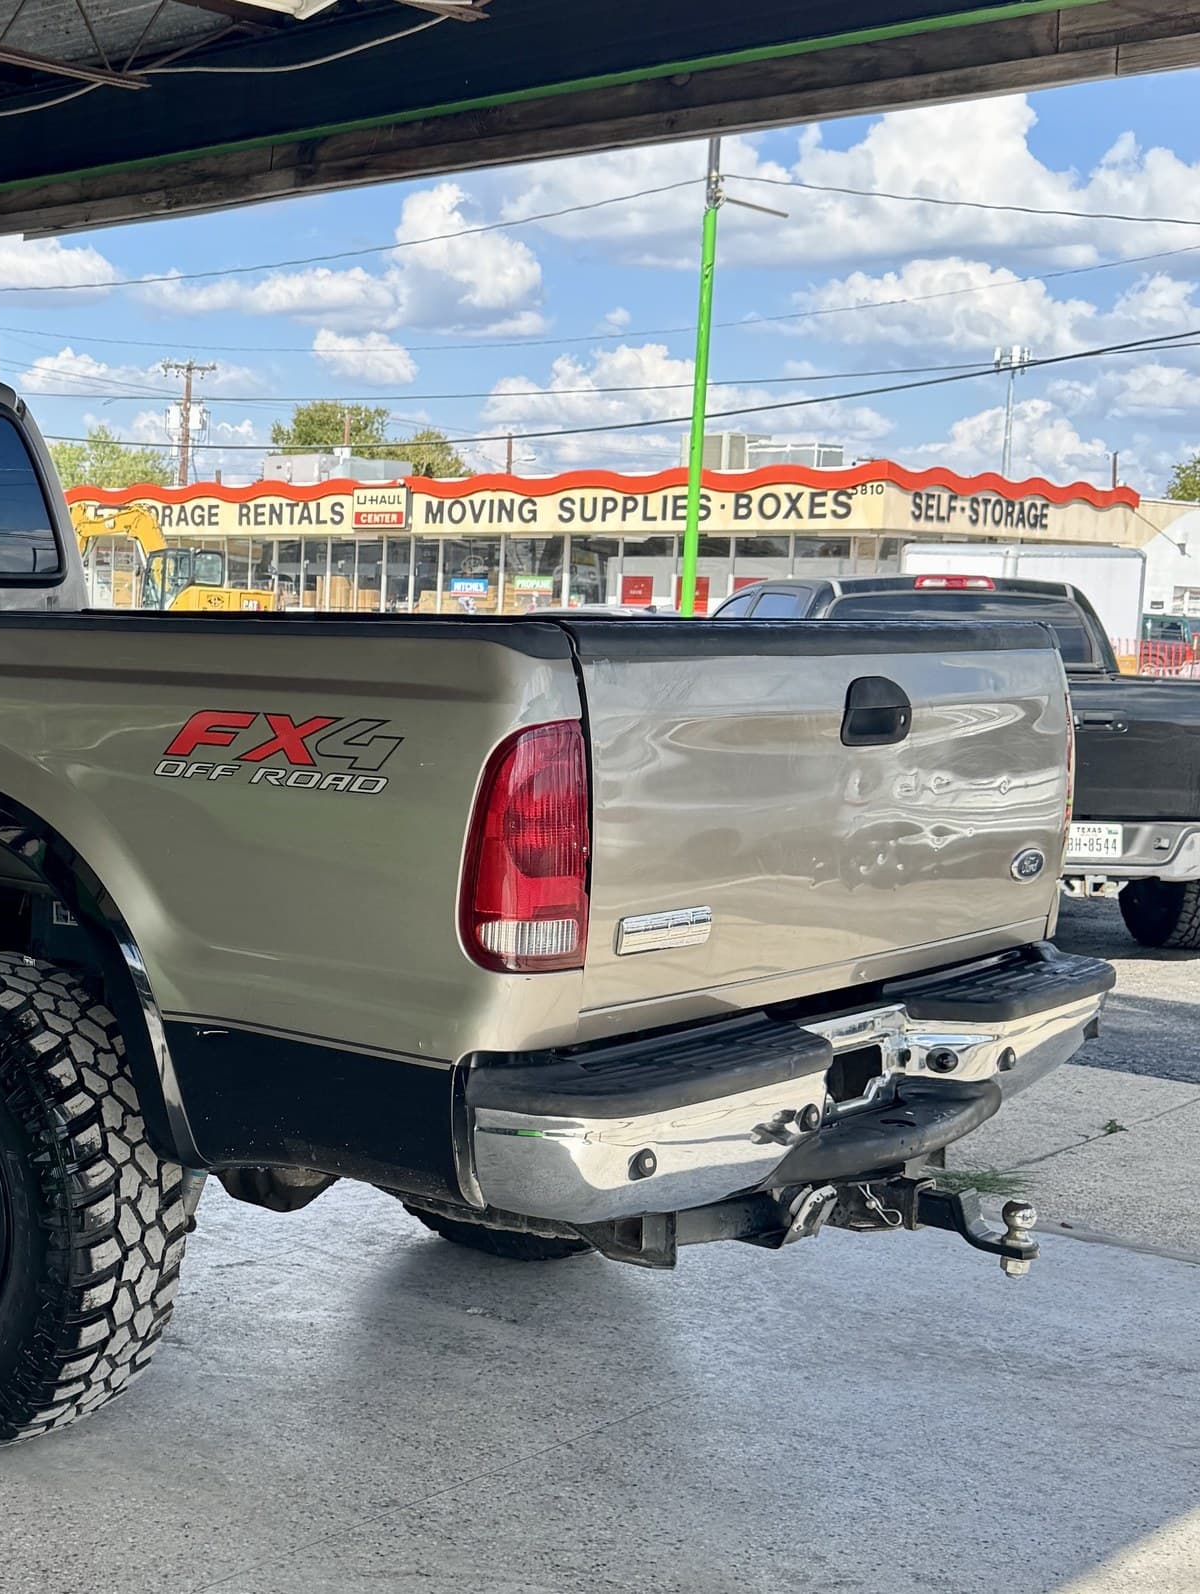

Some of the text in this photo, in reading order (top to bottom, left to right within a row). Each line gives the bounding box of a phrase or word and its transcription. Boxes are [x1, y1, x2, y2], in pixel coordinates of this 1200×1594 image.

[238, 502, 345, 526] RENTALS
[356, 495, 402, 505] U-HAUL
[425, 490, 853, 524] MOVING SUPPLIES BOXES
[360, 513, 398, 524] CENTER
[163, 709, 405, 771] FX4
[154, 759, 389, 794] OFF ROAD
